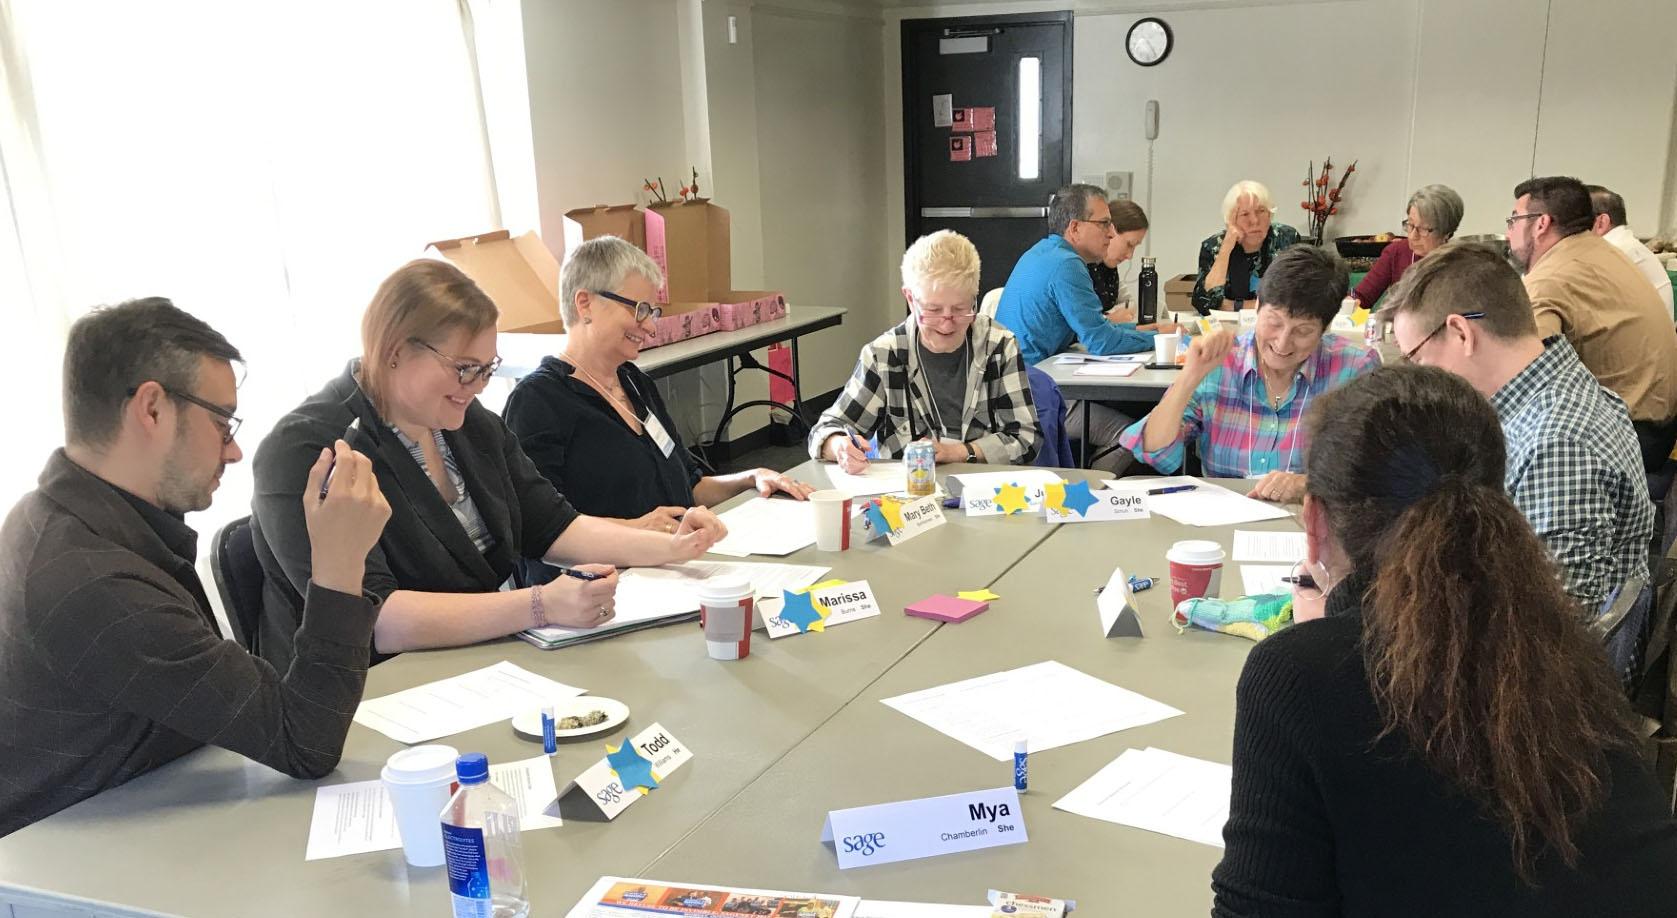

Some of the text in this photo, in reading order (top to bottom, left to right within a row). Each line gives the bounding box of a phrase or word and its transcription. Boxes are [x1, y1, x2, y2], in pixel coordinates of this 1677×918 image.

[969, 498, 992, 511] sage
[1110, 495, 1142, 507] Gayle
[903, 509, 922, 522] Mary
[920, 502, 937, 515] Beth
[818, 590, 867, 608] Marissa
[640, 732, 671, 756] Todd
[596, 781, 624, 806] sage
[968, 802, 1011, 823] Mya
[940, 823, 1015, 842] Chamberlin She
[843, 831, 886, 857] sage
